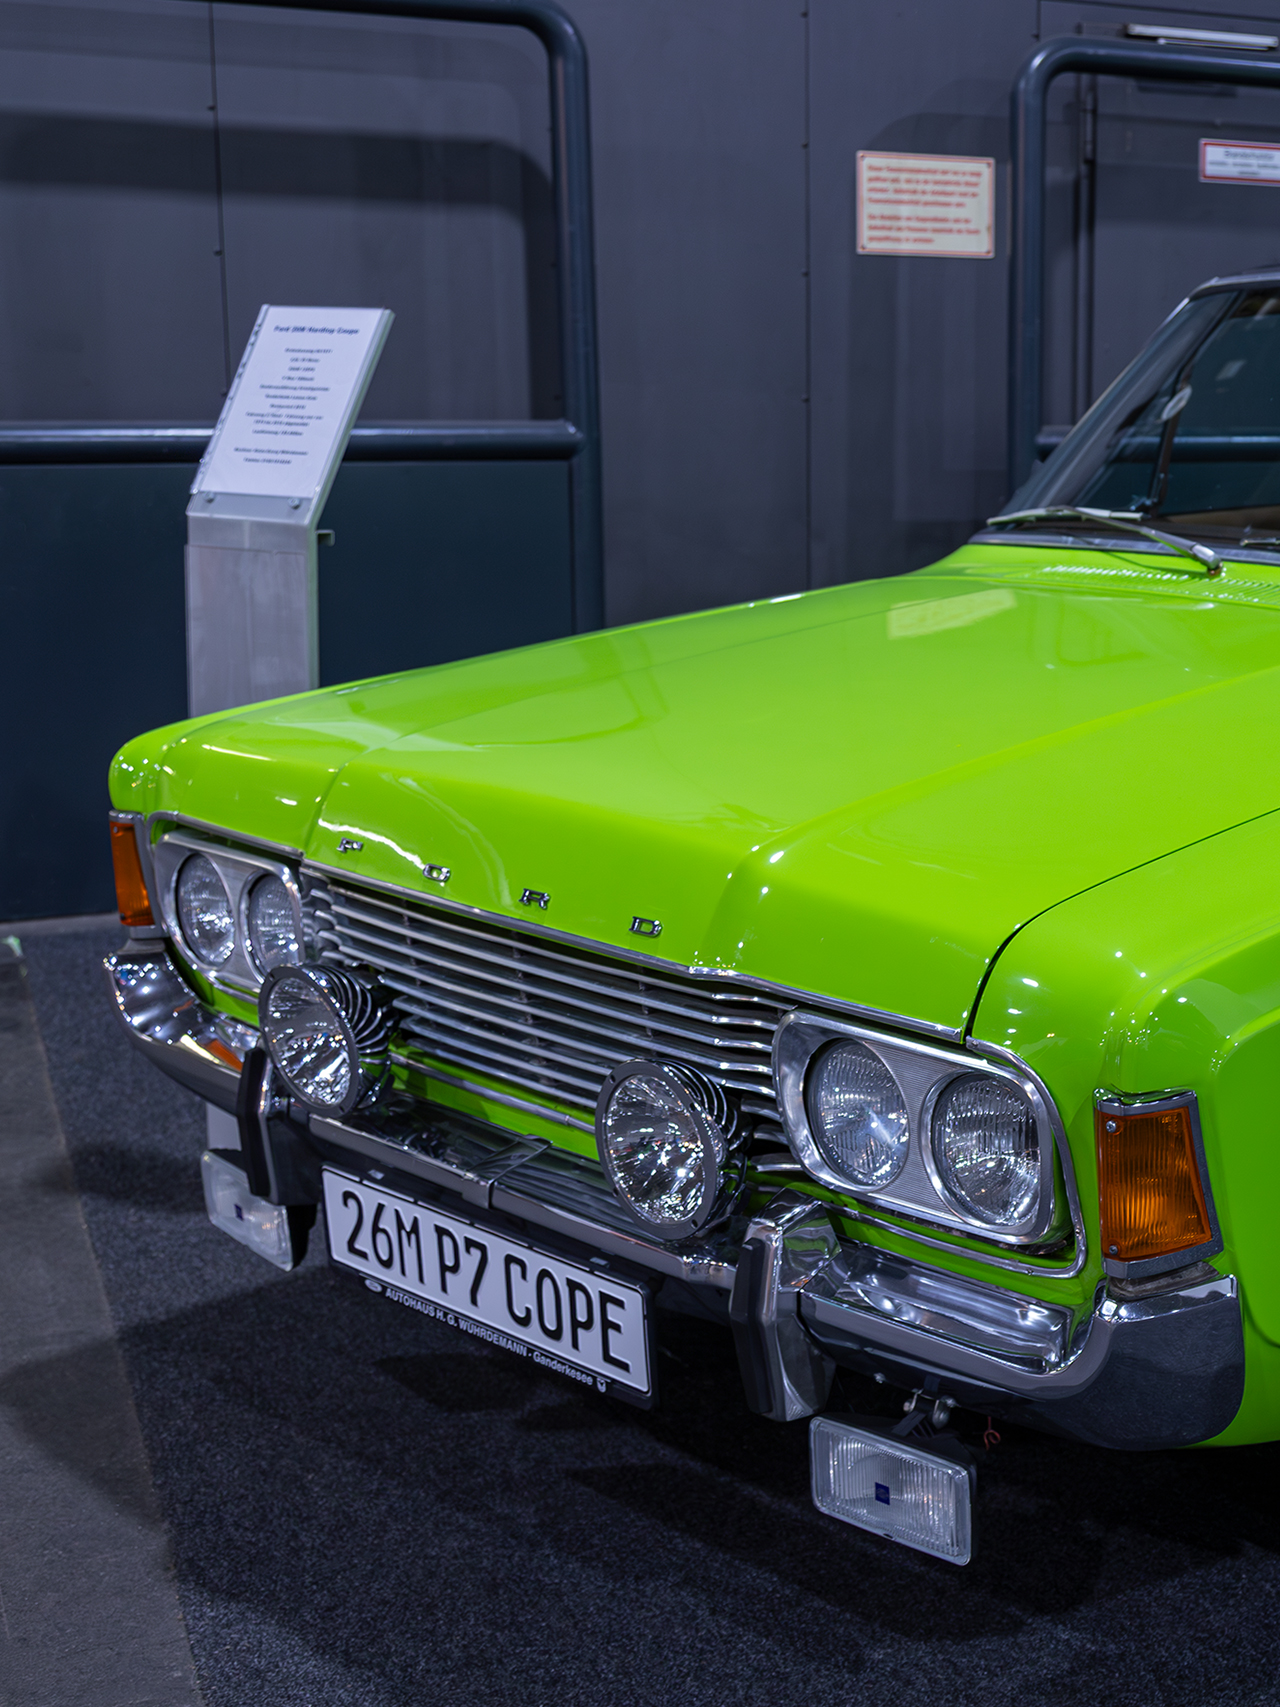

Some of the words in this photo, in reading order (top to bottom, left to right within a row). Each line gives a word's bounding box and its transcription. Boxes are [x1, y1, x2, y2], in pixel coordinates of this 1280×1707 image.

[342, 1189, 426, 1286] 26M
[434, 1223, 489, 1307] P7
[504, 1253, 631, 1374] COPE
[385, 1288, 435, 1317] AUTOHAUS
[436, 1310, 446, 1322] H.
[447, 1314, 458, 1327] G.
[533, 1351, 593, 1386] Ganderkesee
